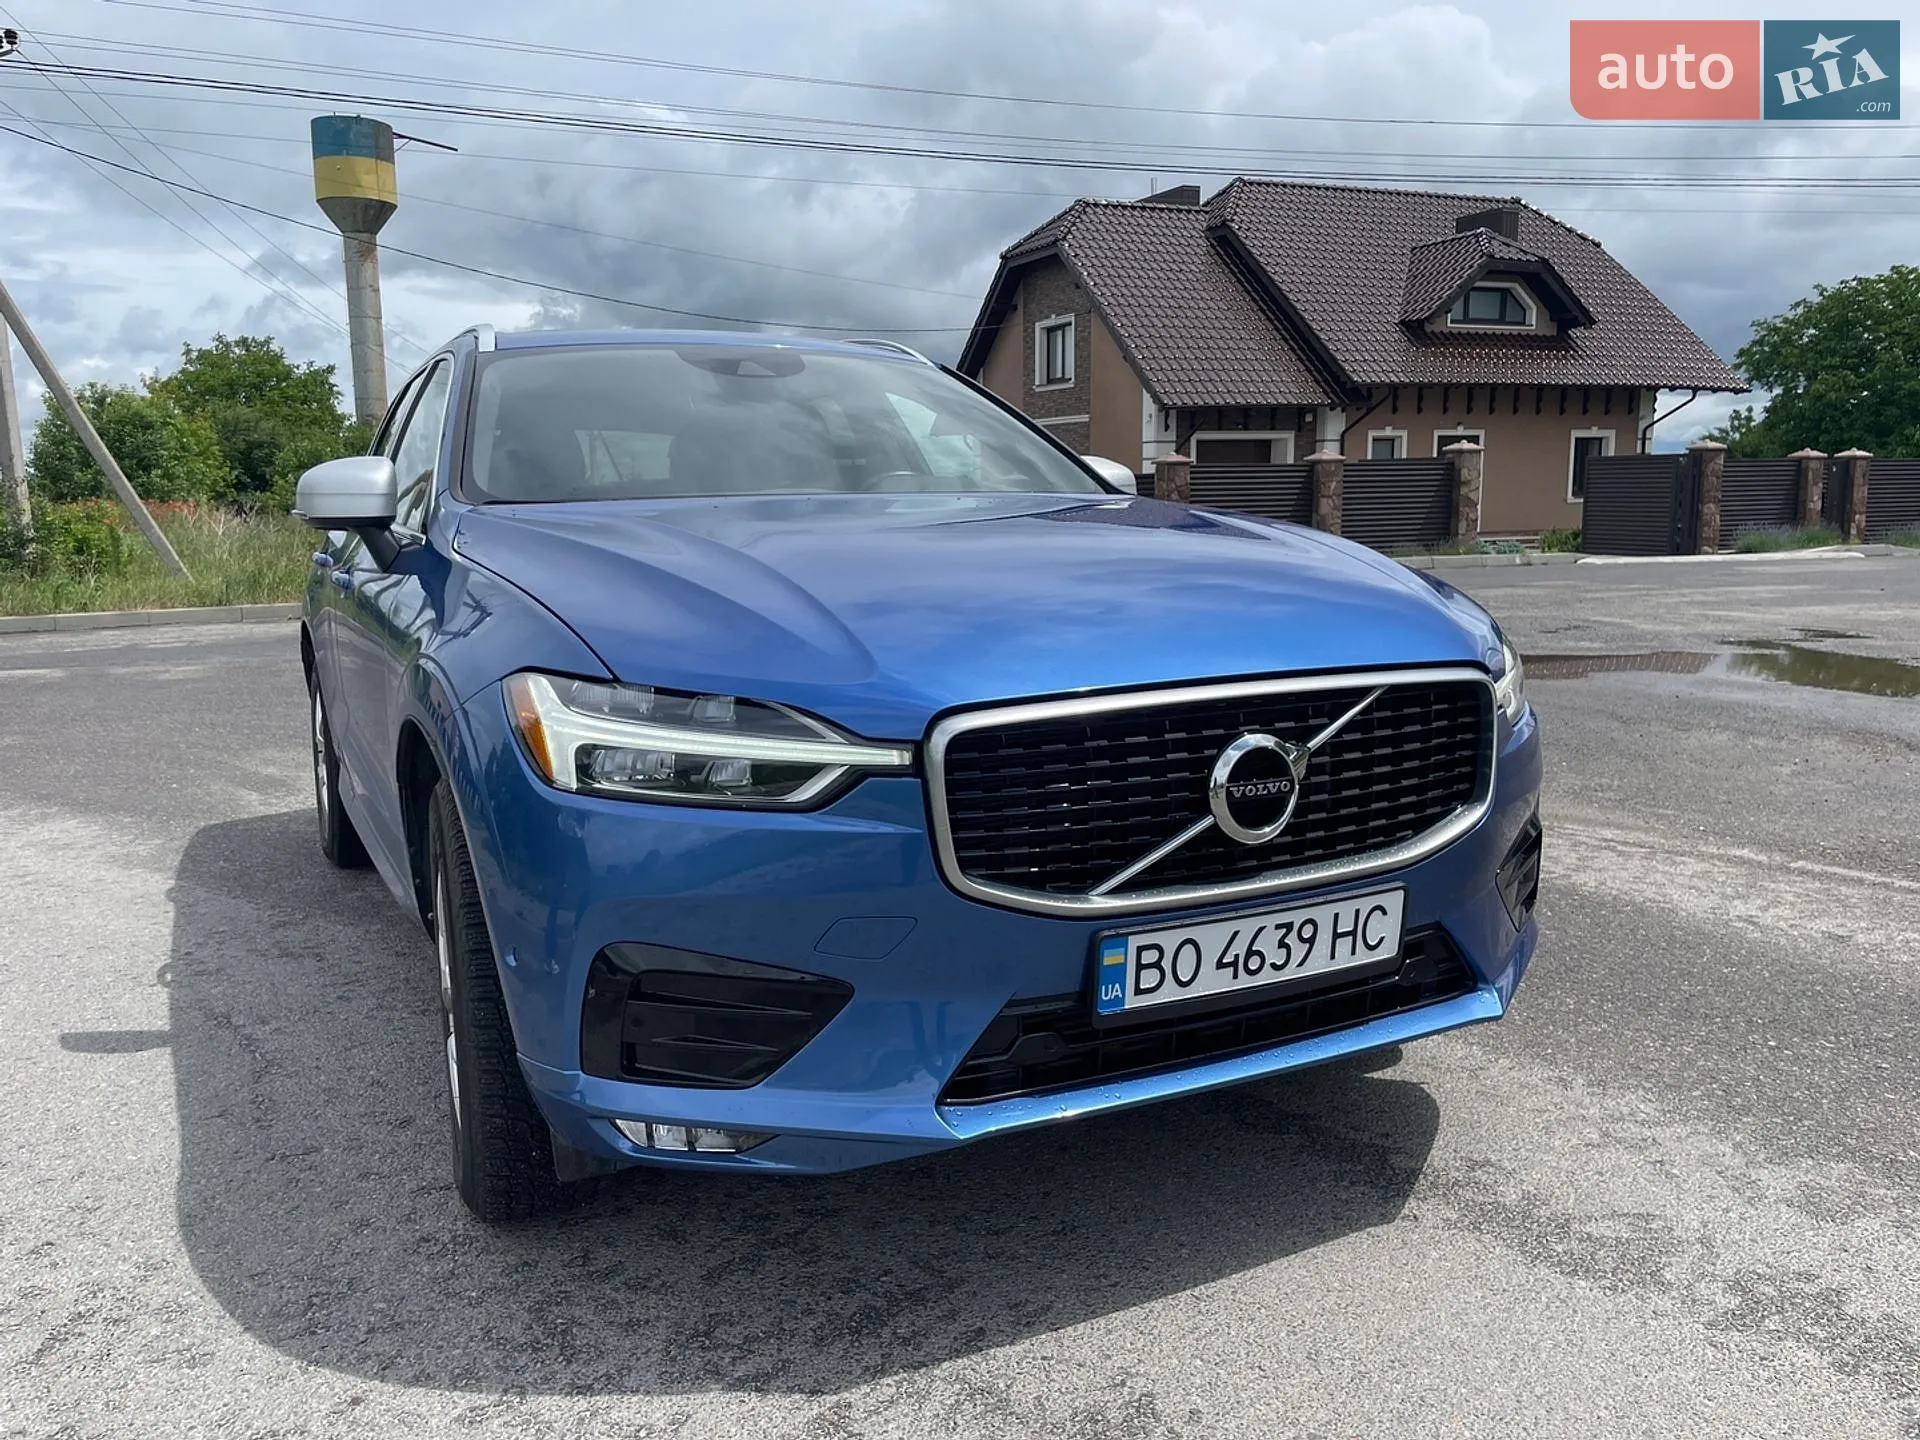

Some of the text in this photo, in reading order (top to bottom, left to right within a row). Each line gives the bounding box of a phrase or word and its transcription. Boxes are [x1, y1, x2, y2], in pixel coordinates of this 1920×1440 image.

[1229, 781, 1290, 798] VOLVO
[1133, 904, 1388, 996] BO 4639 HC
[1101, 983, 1122, 1000] UA
